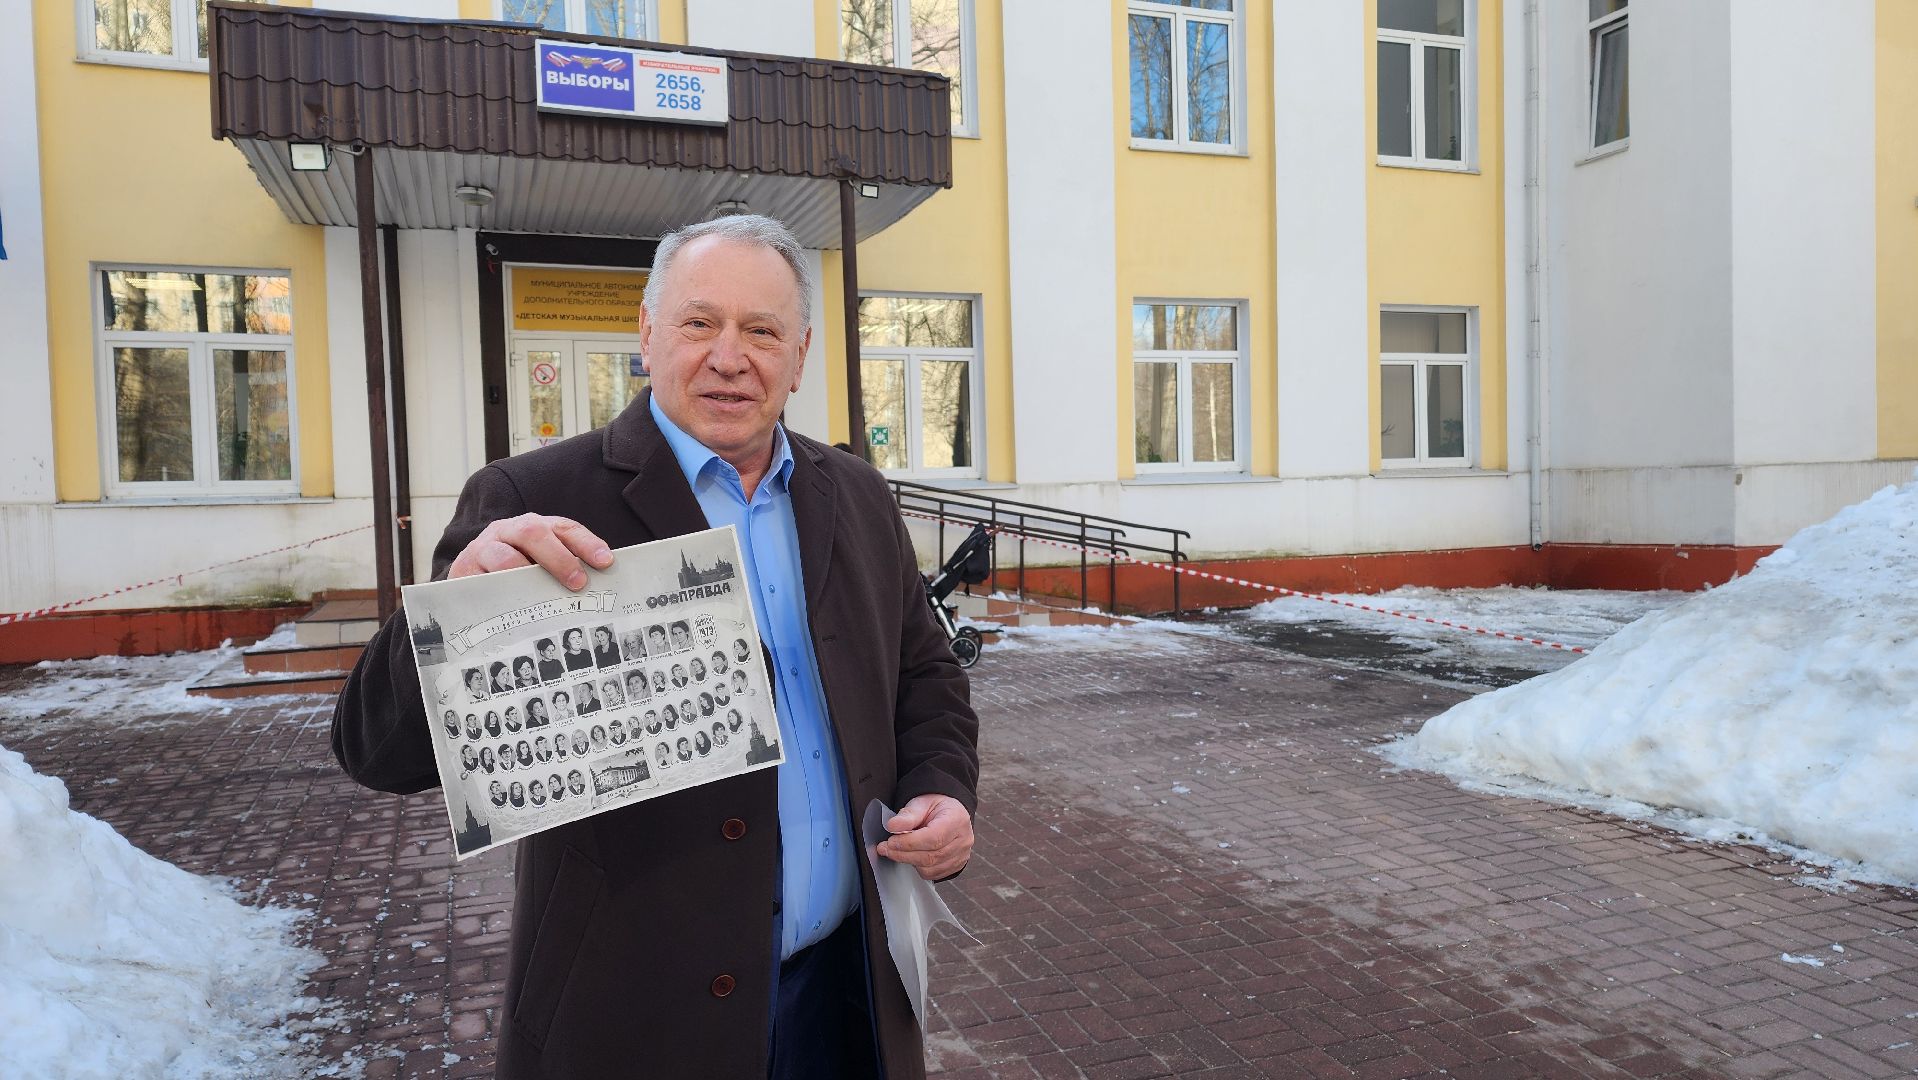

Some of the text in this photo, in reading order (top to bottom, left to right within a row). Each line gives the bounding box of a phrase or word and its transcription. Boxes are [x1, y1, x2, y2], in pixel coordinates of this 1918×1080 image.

[546, 70, 630, 92] ВЫБОРЫ
[655, 73, 705, 94] 2656,
[656, 92, 701, 111] 2658
[530, 280, 601, 290] МУНИЦИПАЛЬНОЕ
[523, 296, 605, 306] ДОПОЛНИТЕЛЬНОГО
[567, 290, 620, 298] УЧРЕЖДЕНИЕ
[560, 313, 620, 322] МУЗЫКАЛЬНАЯ
[679, 581, 731, 603] ПРАВДА
